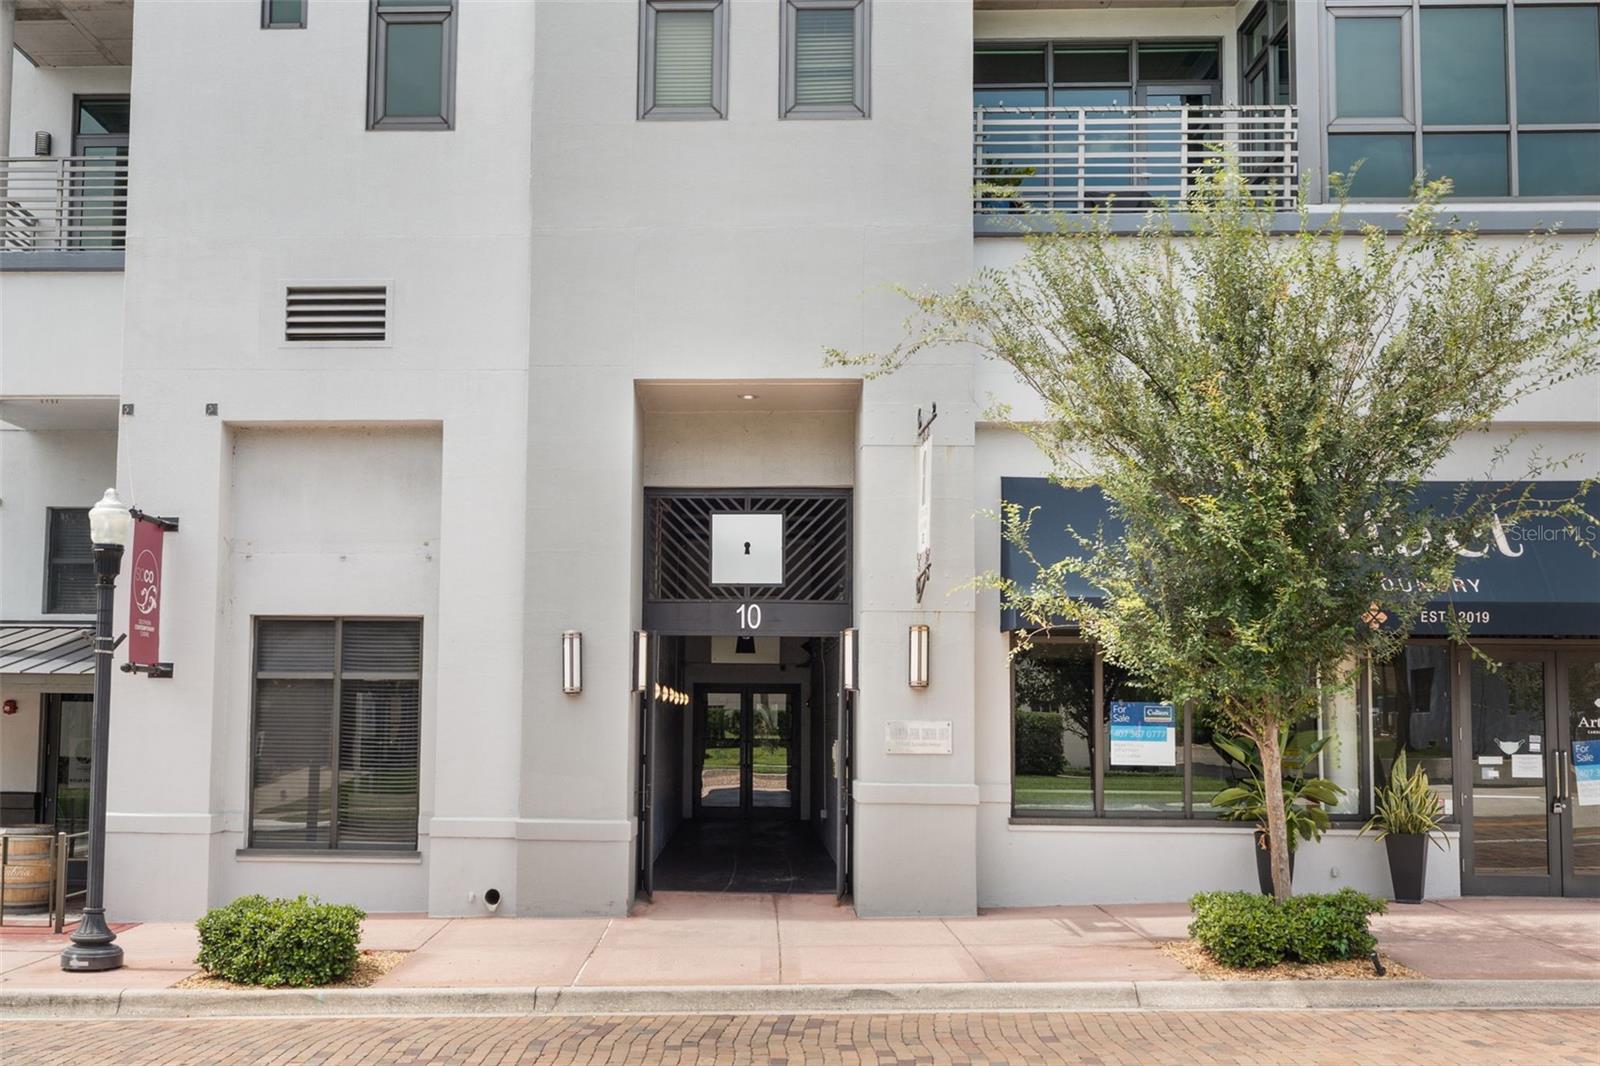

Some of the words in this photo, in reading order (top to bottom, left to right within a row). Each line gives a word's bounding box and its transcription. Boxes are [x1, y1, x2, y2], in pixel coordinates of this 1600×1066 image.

[736, 603, 762, 630] 10
[1458, 610, 1490, 624] 2019
[1112, 704, 1127, 714] For
[1112, 713, 1130, 723] Sale
[1575, 744, 1590, 754] For
[1576, 753, 1594, 762] Sale
